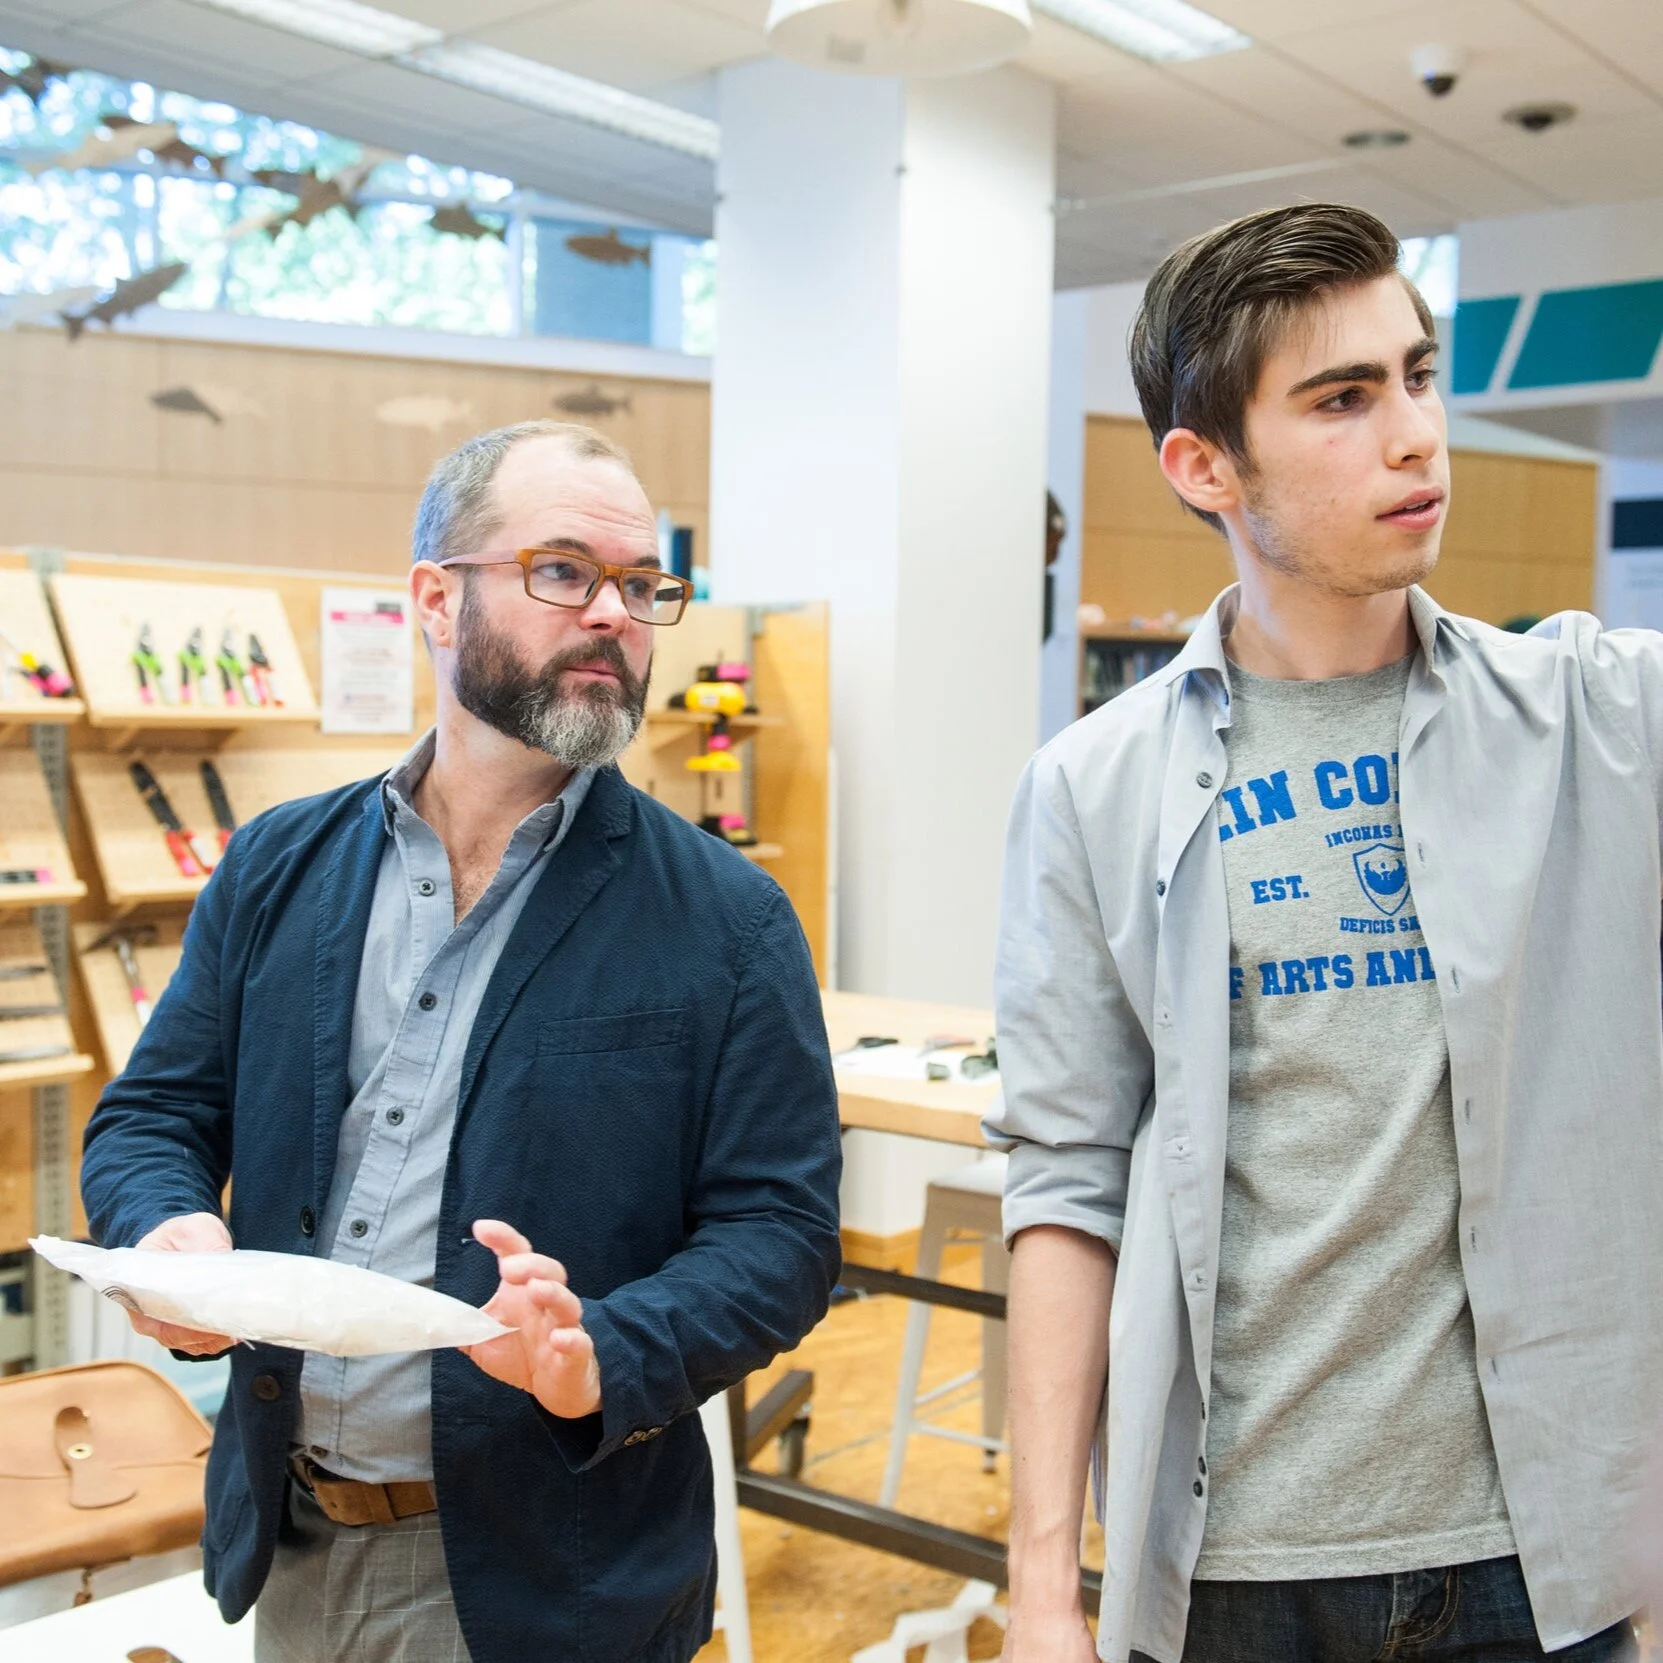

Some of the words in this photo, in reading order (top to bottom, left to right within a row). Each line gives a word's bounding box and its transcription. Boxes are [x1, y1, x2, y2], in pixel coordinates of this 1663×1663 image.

[1314, 752, 1399, 810] CO
[1250, 875, 1310, 904] EST.
[1340, 917, 1395, 934] DEFICIS
[1258, 954, 1354, 996] ARTS
